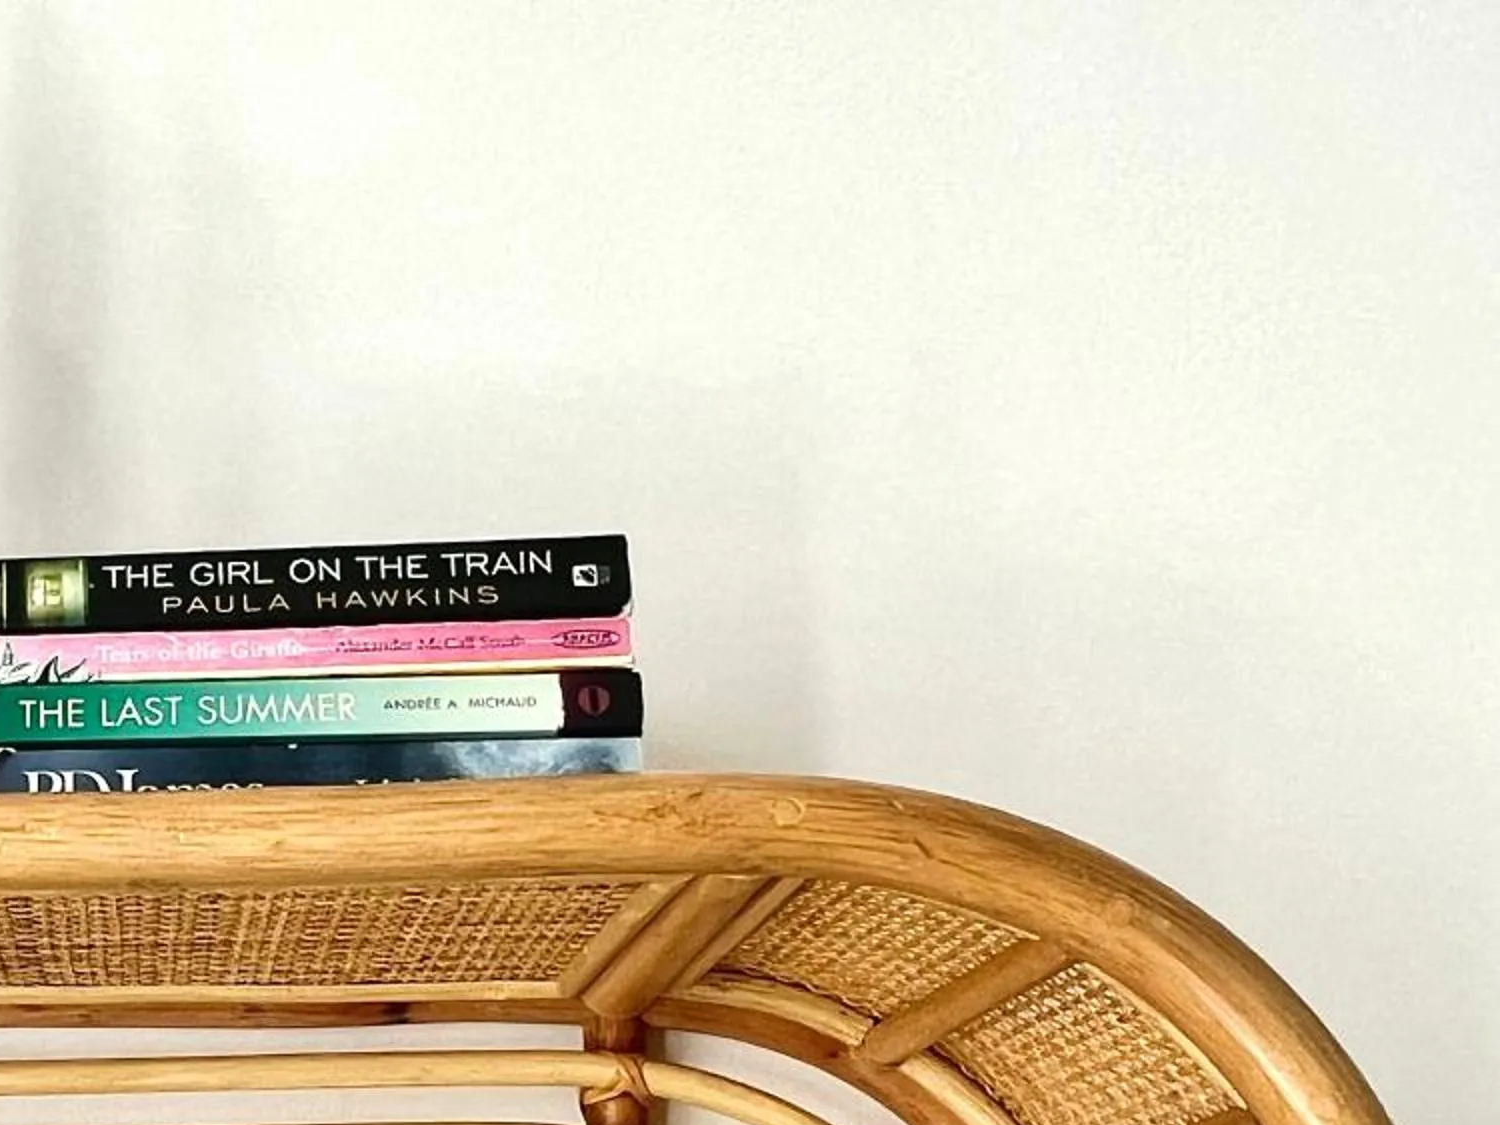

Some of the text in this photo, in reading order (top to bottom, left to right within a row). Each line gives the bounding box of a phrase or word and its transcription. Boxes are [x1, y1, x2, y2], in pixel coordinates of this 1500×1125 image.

[101, 549, 553, 589] THE GIRL ON THE TRAIN
[161, 584, 500, 615] PAULA HAWKINS
[186, 640, 223, 661] the
[18, 691, 357, 729] THE LAST SUMMER
[467, 695, 537, 710] MICHAUD
